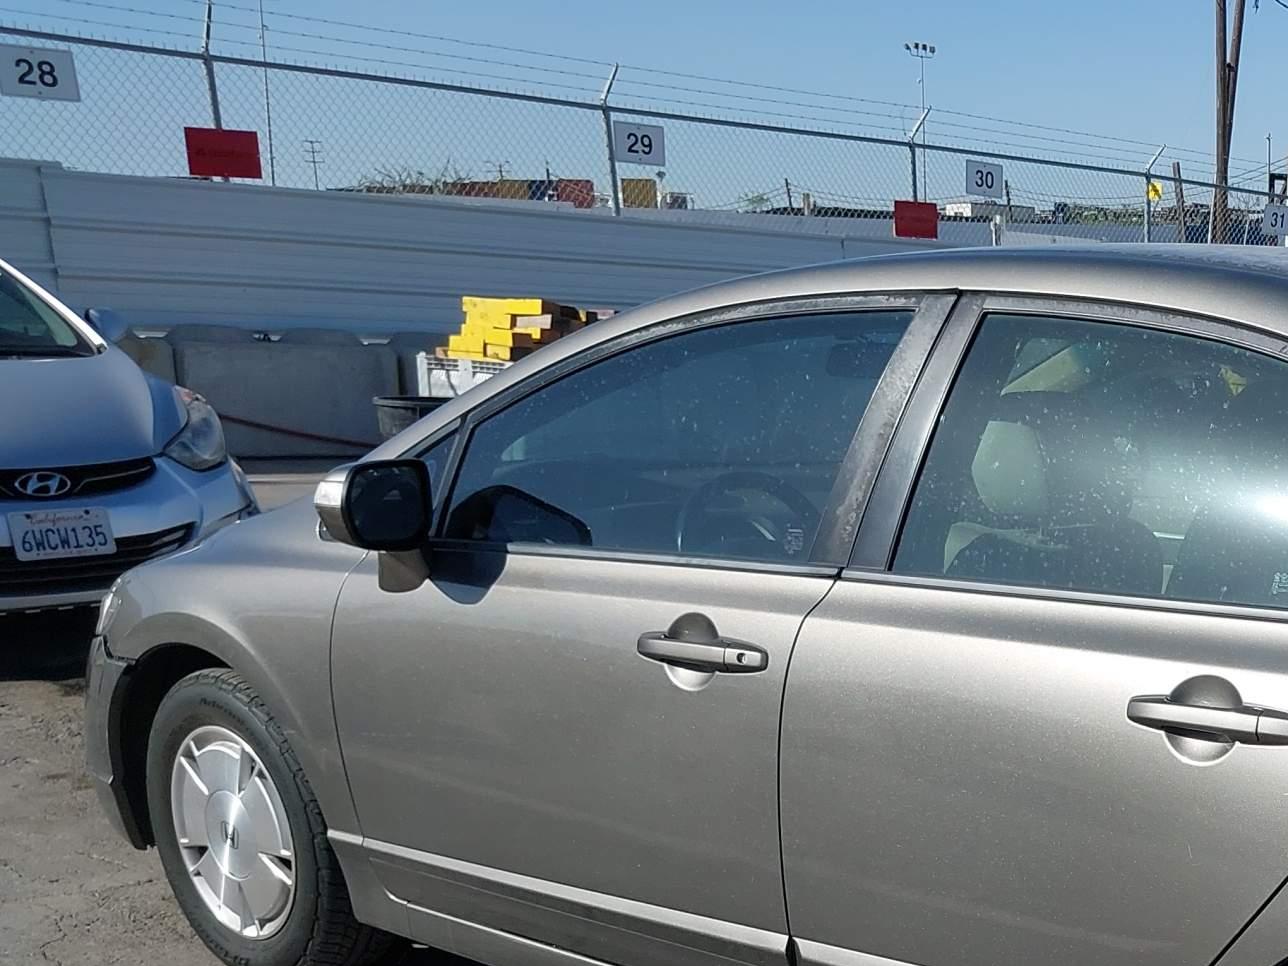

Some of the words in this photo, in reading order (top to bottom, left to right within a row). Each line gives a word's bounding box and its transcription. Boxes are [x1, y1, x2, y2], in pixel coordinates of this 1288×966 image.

[15, 58, 59, 88] 28
[626, 132, 653, 156] 29
[975, 169, 994, 189] 30
[1270, 212, 1285, 229] 31
[22, 525, 108, 552] 6WCW135
